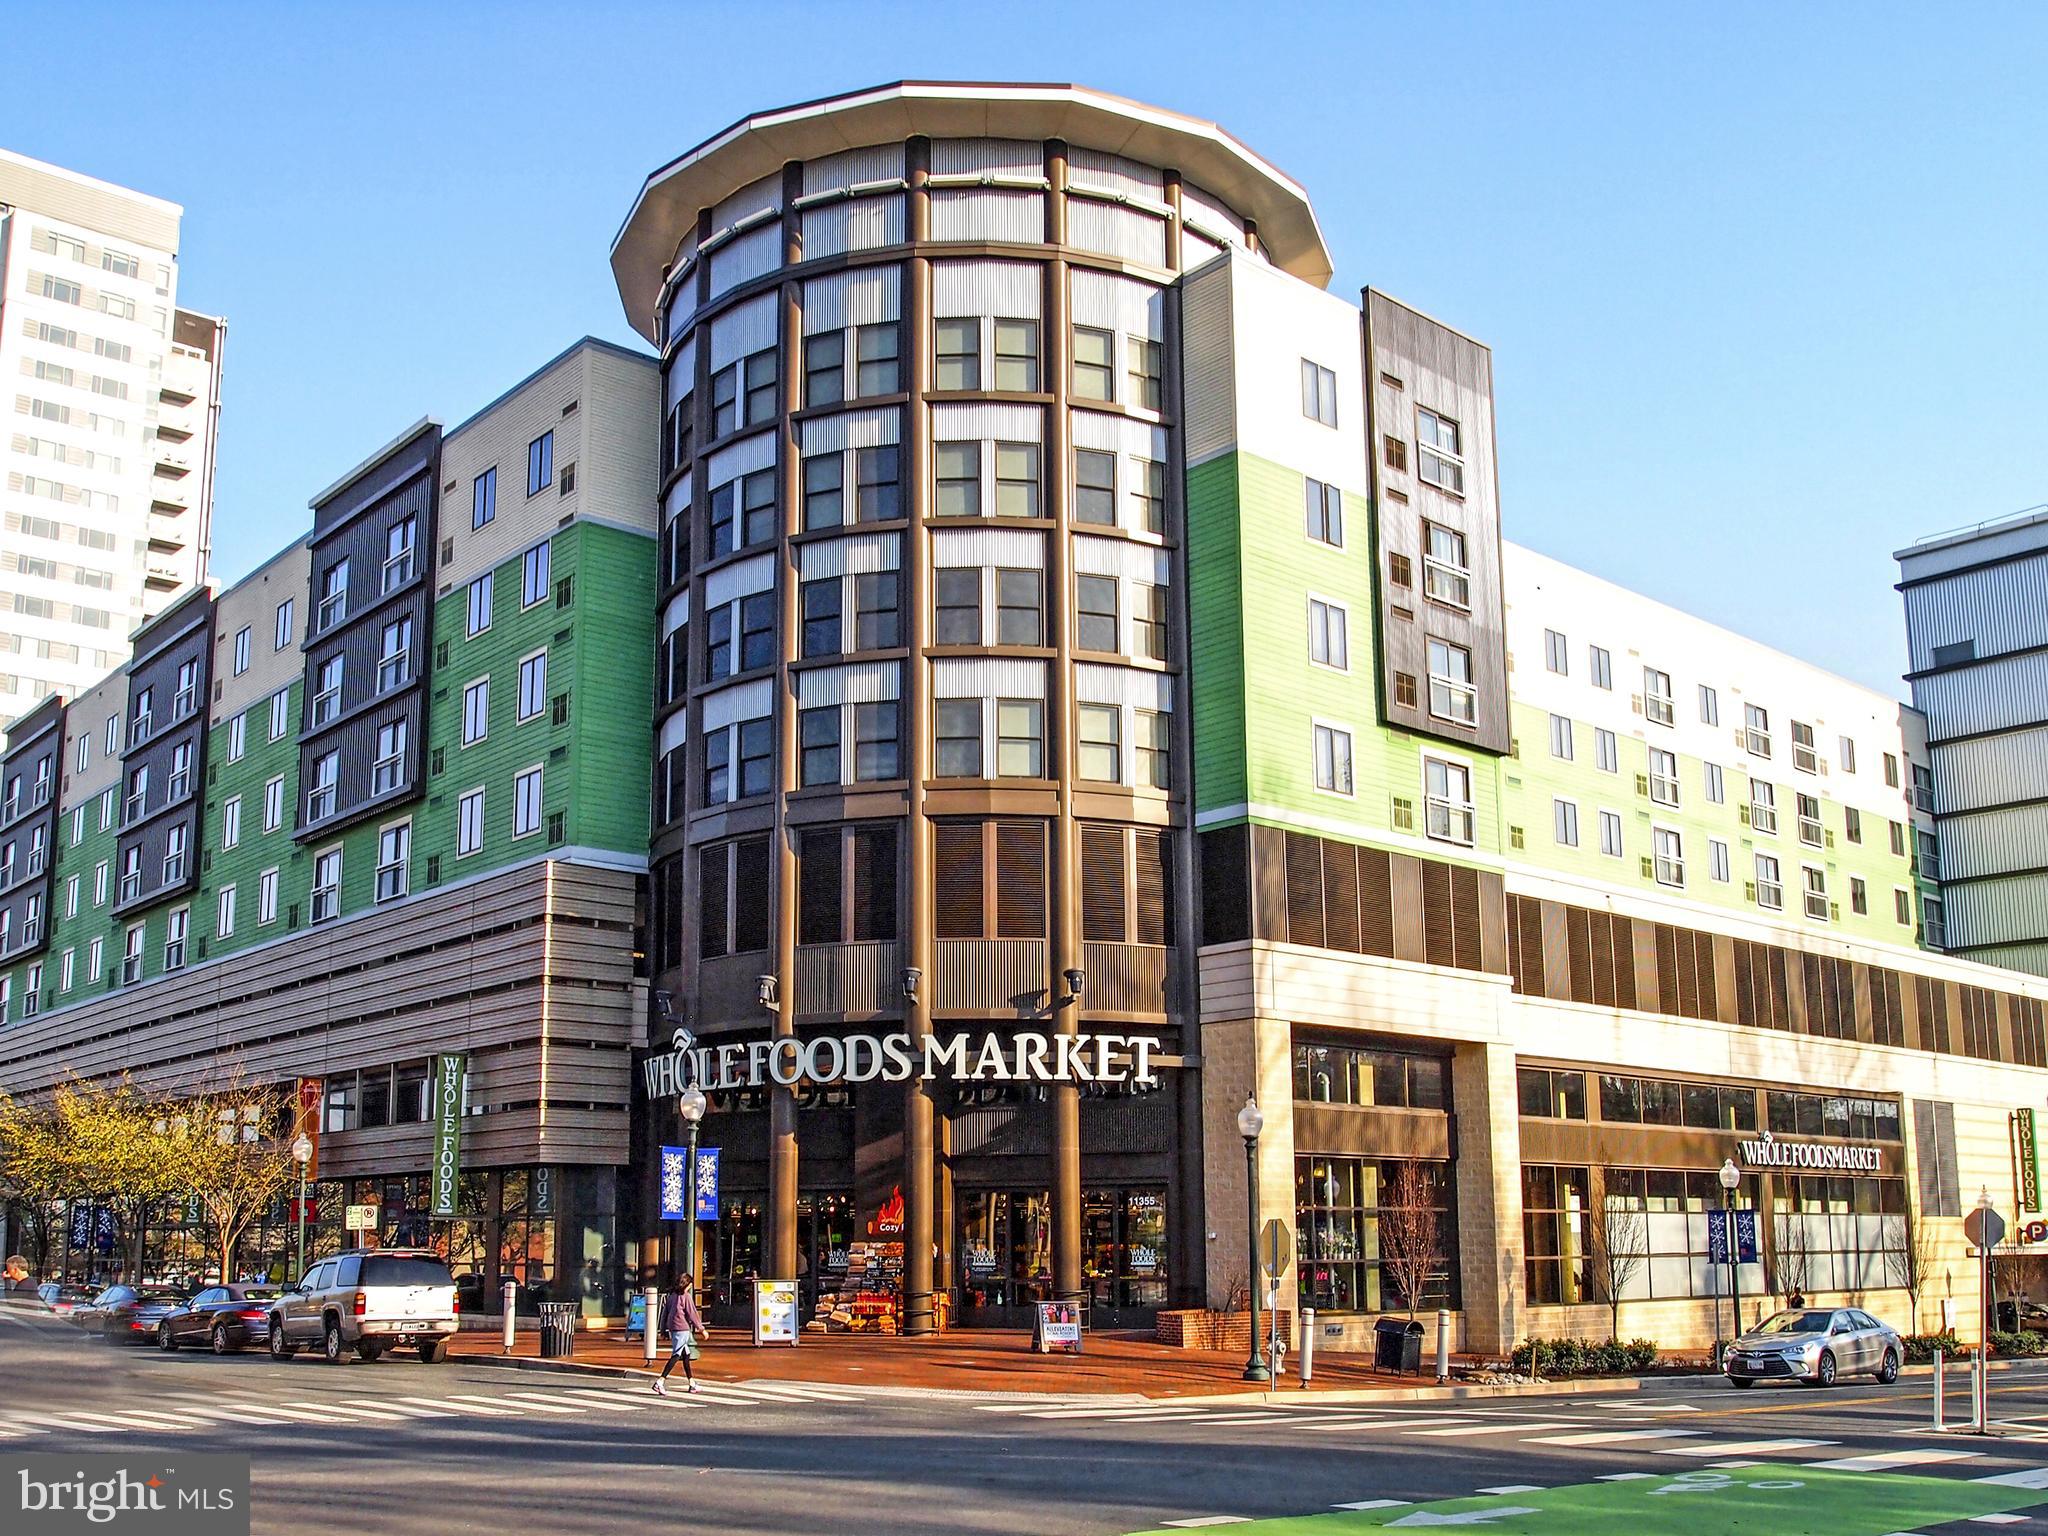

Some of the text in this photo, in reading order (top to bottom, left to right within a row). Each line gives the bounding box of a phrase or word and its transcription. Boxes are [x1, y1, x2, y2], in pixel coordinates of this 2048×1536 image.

[643, 1028, 1161, 1100] WHOLE FOODS MARKET
[439, 1057, 460, 1209] WHOLE FOODS
[1741, 1130, 1882, 1170] WHOLE FOODS MARKET
[2019, 1109, 2037, 1208] WHOLE FOODS
[1128, 1196, 1156, 1206] 11355
[880, 1223, 900, 1233] Cozy
[2031, 1225, 2043, 1239] P
